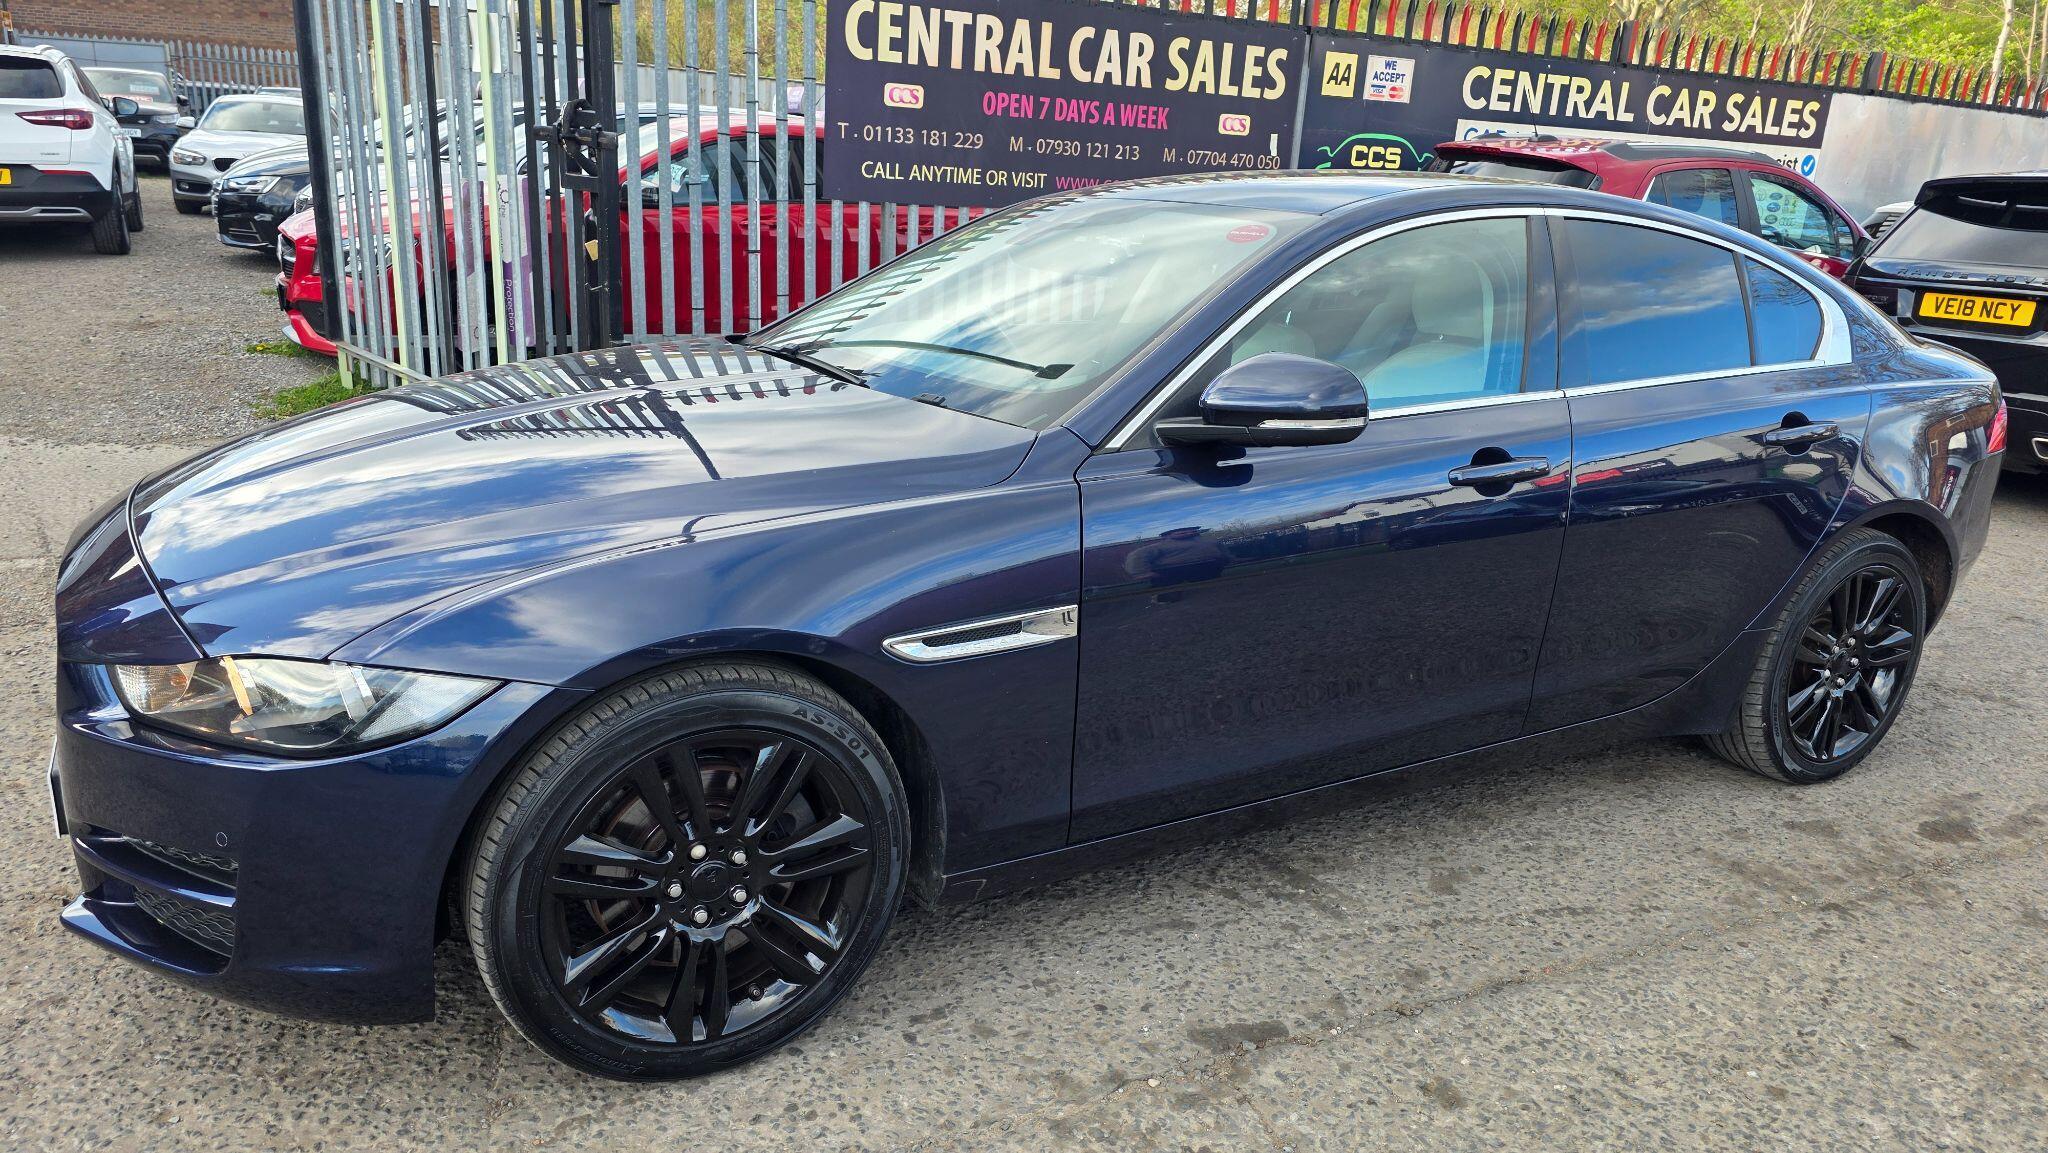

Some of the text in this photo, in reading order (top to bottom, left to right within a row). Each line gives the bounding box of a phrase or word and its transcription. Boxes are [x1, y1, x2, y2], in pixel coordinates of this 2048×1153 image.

[845, 0, 1289, 100] CENTRAL CAR SALES
[1326, 62, 1353, 87] AA
[1372, 70, 1406, 84] ACCEPT
[1384, 59, 1398, 71] WE
[888, 86, 920, 105] CCS
[1462, 65, 1821, 139] CENTRAL CAR SALES
[982, 90, 1170, 130] OPEN 7 DAYS A WEEK
[863, 124, 914, 144] 01133
[921, 129, 947, 147] 181
[953, 131, 984, 149] 229
[1222, 116, 1247, 132] CCS
[1036, 138, 1081, 157] 07930
[1086, 142, 1108, 158] 121
[1114, 144, 1140, 160] 213
[1187, 149, 1226, 166] 07704
[1230, 152, 1254, 168] 470
[1257, 154, 1281, 170] 050
[1350, 144, 1402, 169] CCS
[861, 160, 904, 180] CALL
[909, 164, 982, 185] ANYTIME
[985, 169, 1008, 186] OR
[1011, 171, 1048, 188] VISIT
[1897, 268, 2048, 285] RANGE ROVE
[506, 279, 516, 332] Protection
[1934, 296, 2022, 321] VE18 NCY
